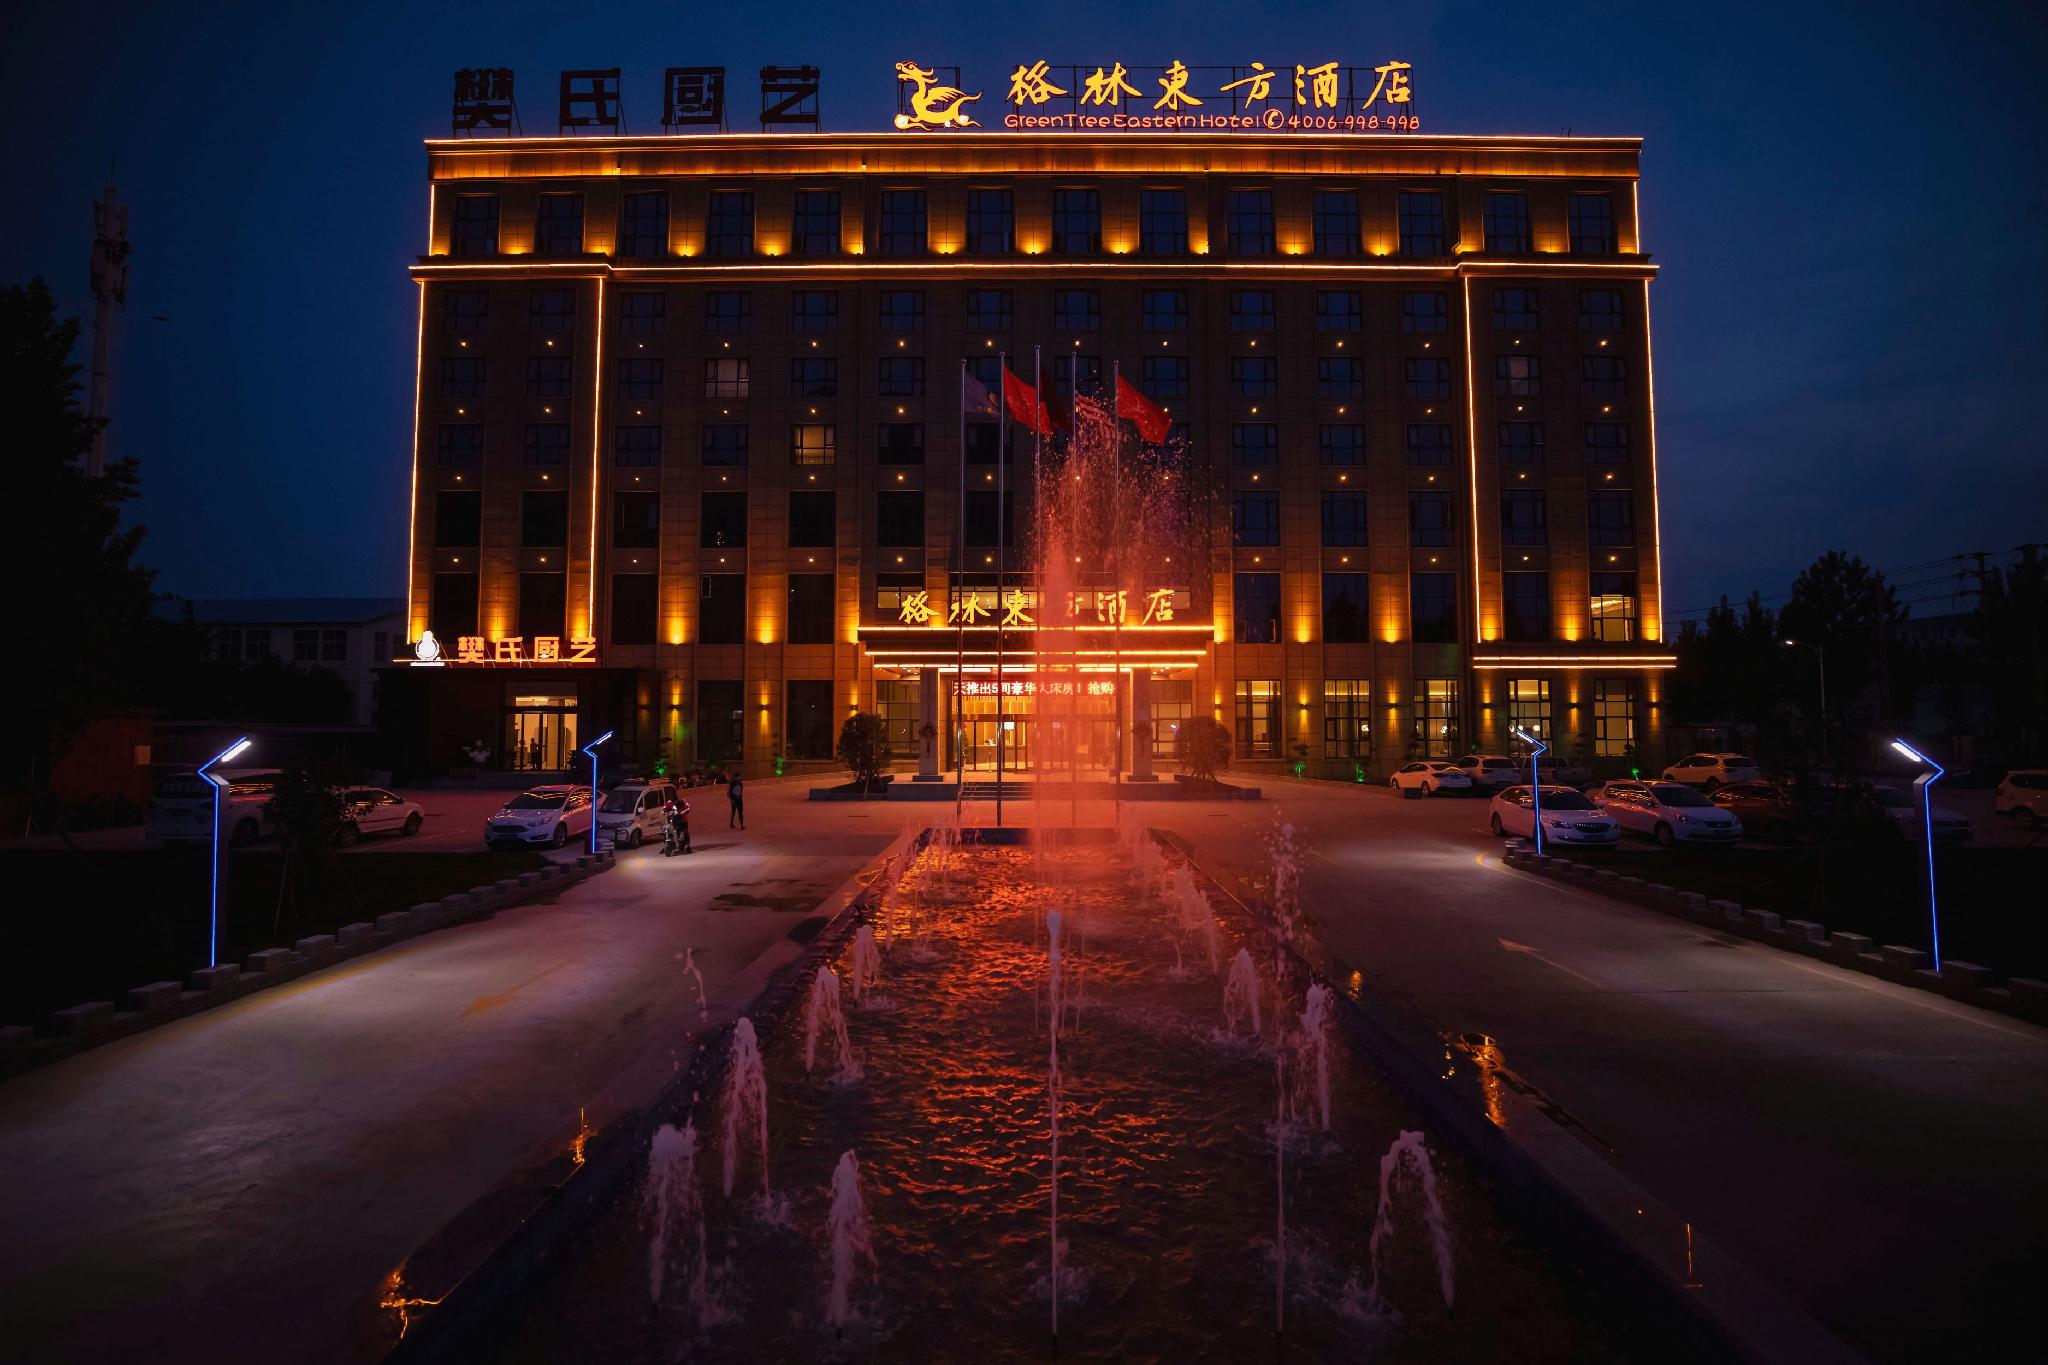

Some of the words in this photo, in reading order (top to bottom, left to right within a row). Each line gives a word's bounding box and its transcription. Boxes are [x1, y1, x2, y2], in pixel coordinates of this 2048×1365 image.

[1004, 114, 1110, 128] GreenTree
[1113, 114, 1196, 128] Eastern
[1200, 114, 1259, 128] Hotel
[1288, 115, 1420, 129] 4006-998-998
